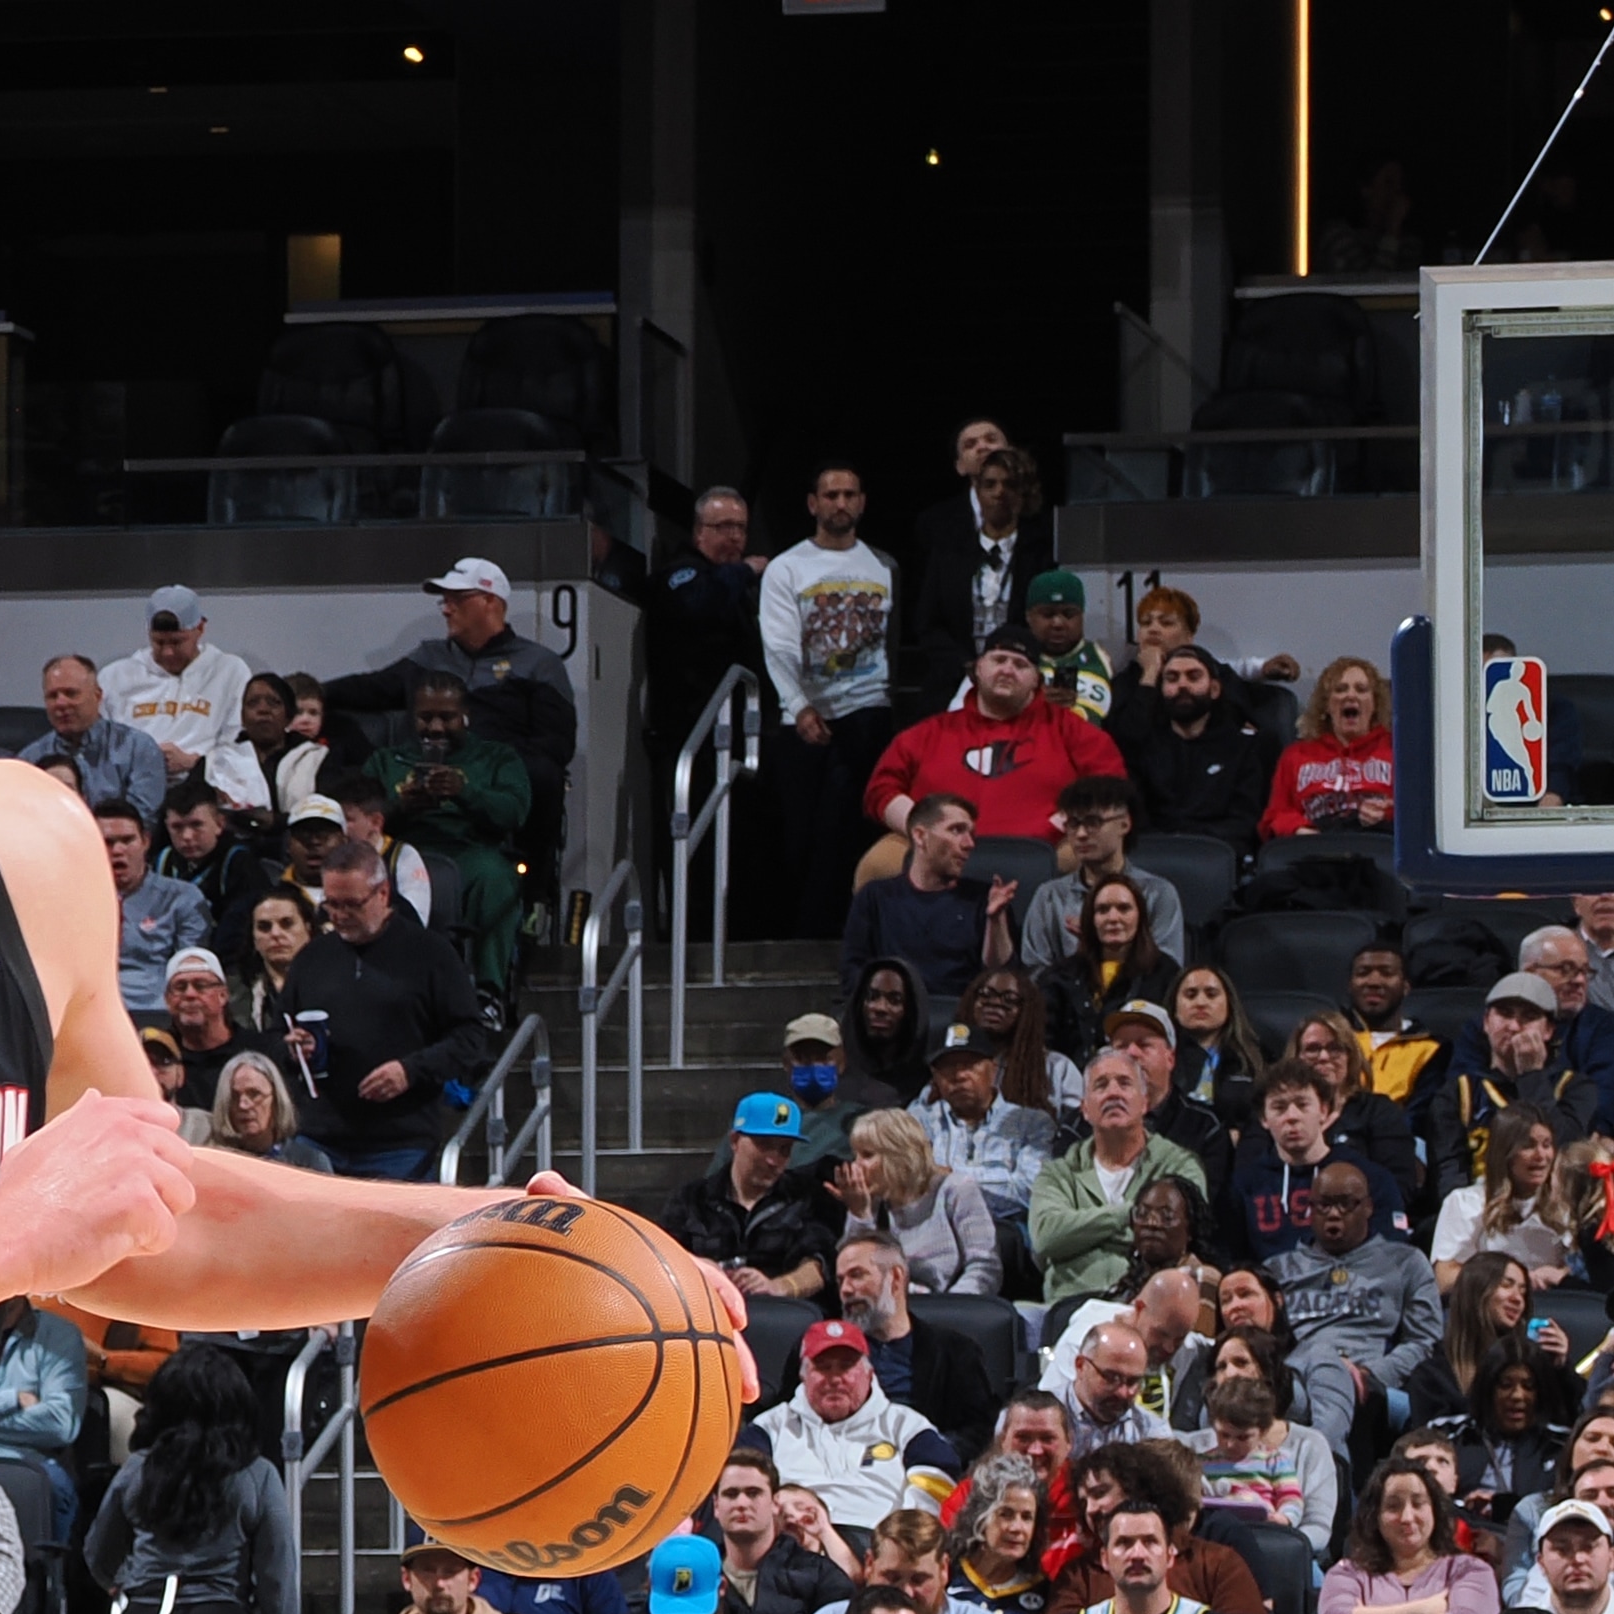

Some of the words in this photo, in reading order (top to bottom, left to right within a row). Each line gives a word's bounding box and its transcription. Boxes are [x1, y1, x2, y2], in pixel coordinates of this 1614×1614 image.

[553, 584, 578, 661] 9
[1117, 571, 1161, 646] 1
[1491, 769, 1522, 792] NBA
[1254, 1189, 1314, 1233] US
[475, 1483, 656, 1572] ilson
